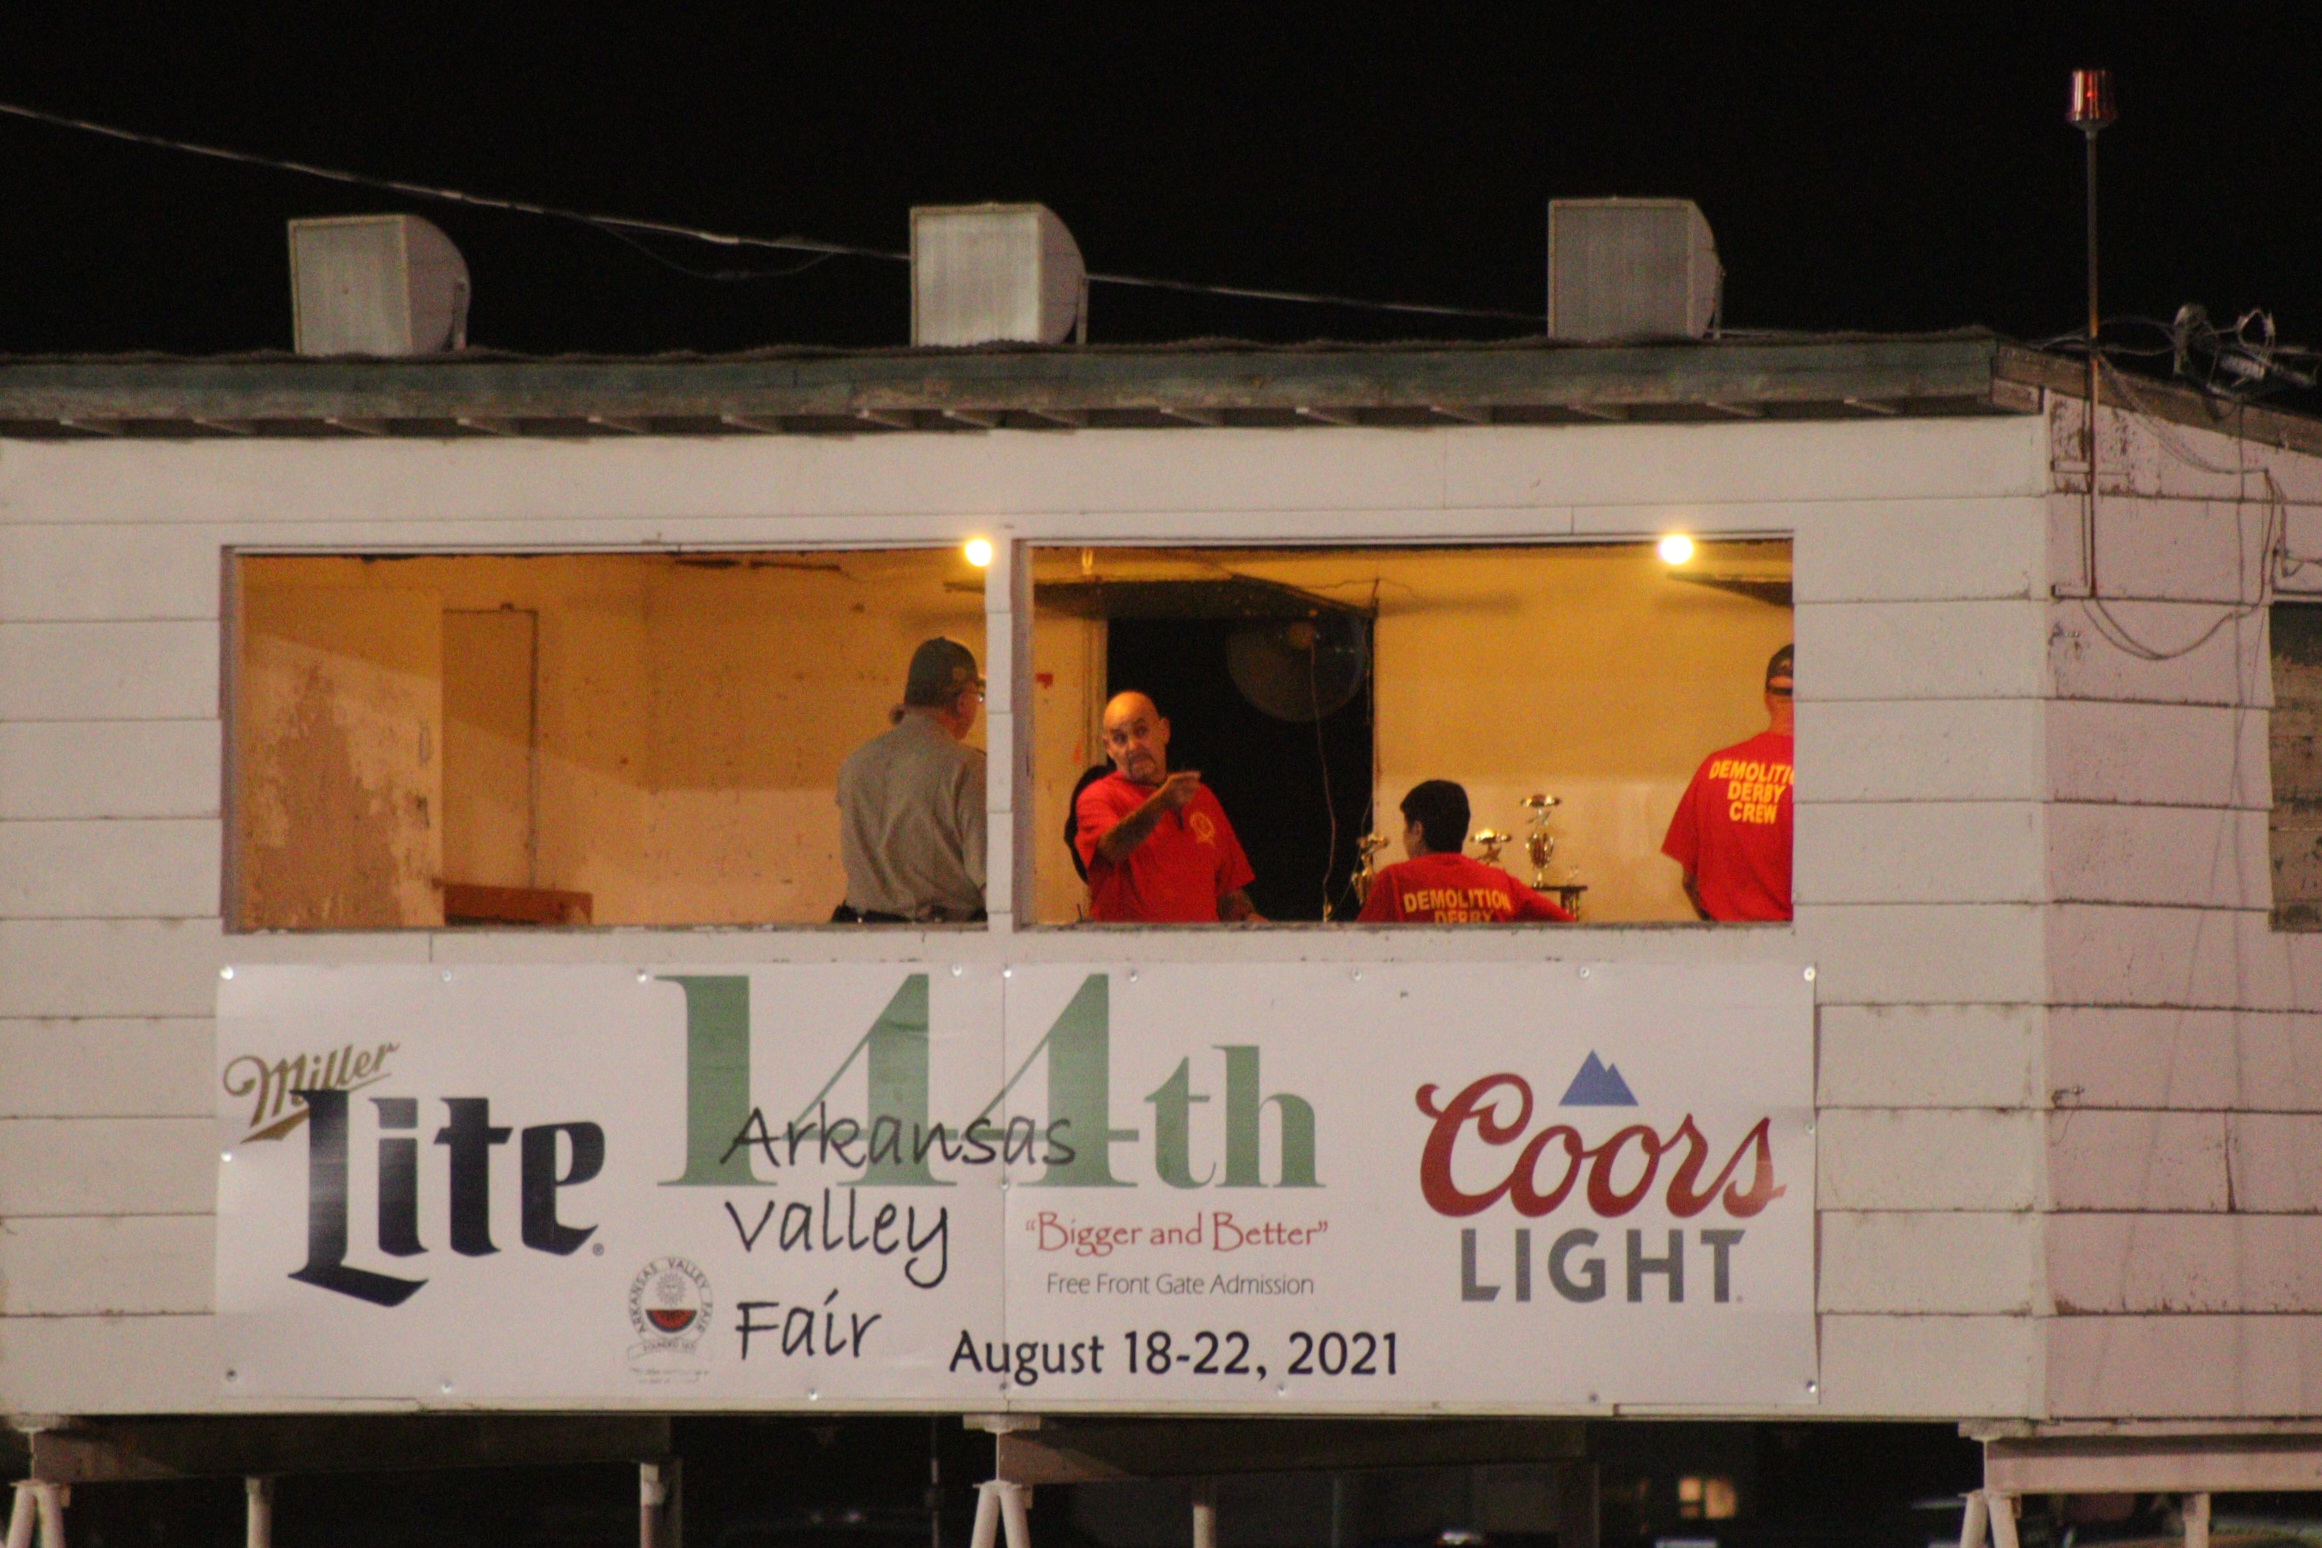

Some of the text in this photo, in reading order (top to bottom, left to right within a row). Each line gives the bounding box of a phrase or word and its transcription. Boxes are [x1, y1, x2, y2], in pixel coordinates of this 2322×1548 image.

[1708, 759, 1795, 786] DEMOLITI
[1727, 780, 1786, 804] DERBY
[1729, 801, 1777, 824] CREW
[1403, 888, 1512, 914] DEMOLITION
[223, 1041, 400, 1128] Miller
[655, 973, 1327, 1189] 144th
[720, 1101, 1076, 1168] Arkansas
[1415, 1072, 1788, 1219] Coors
[287, 1088, 605, 1307] Lite
[1149, 1211, 1202, 1246] and
[1047, 1272, 1315, 1296] Free Front Gate Admission
[1461, 1228, 1746, 1304] LIGHT
[735, 1287, 882, 1361] Fair
[949, 1329, 1398, 1387] August 18-22, 2021
